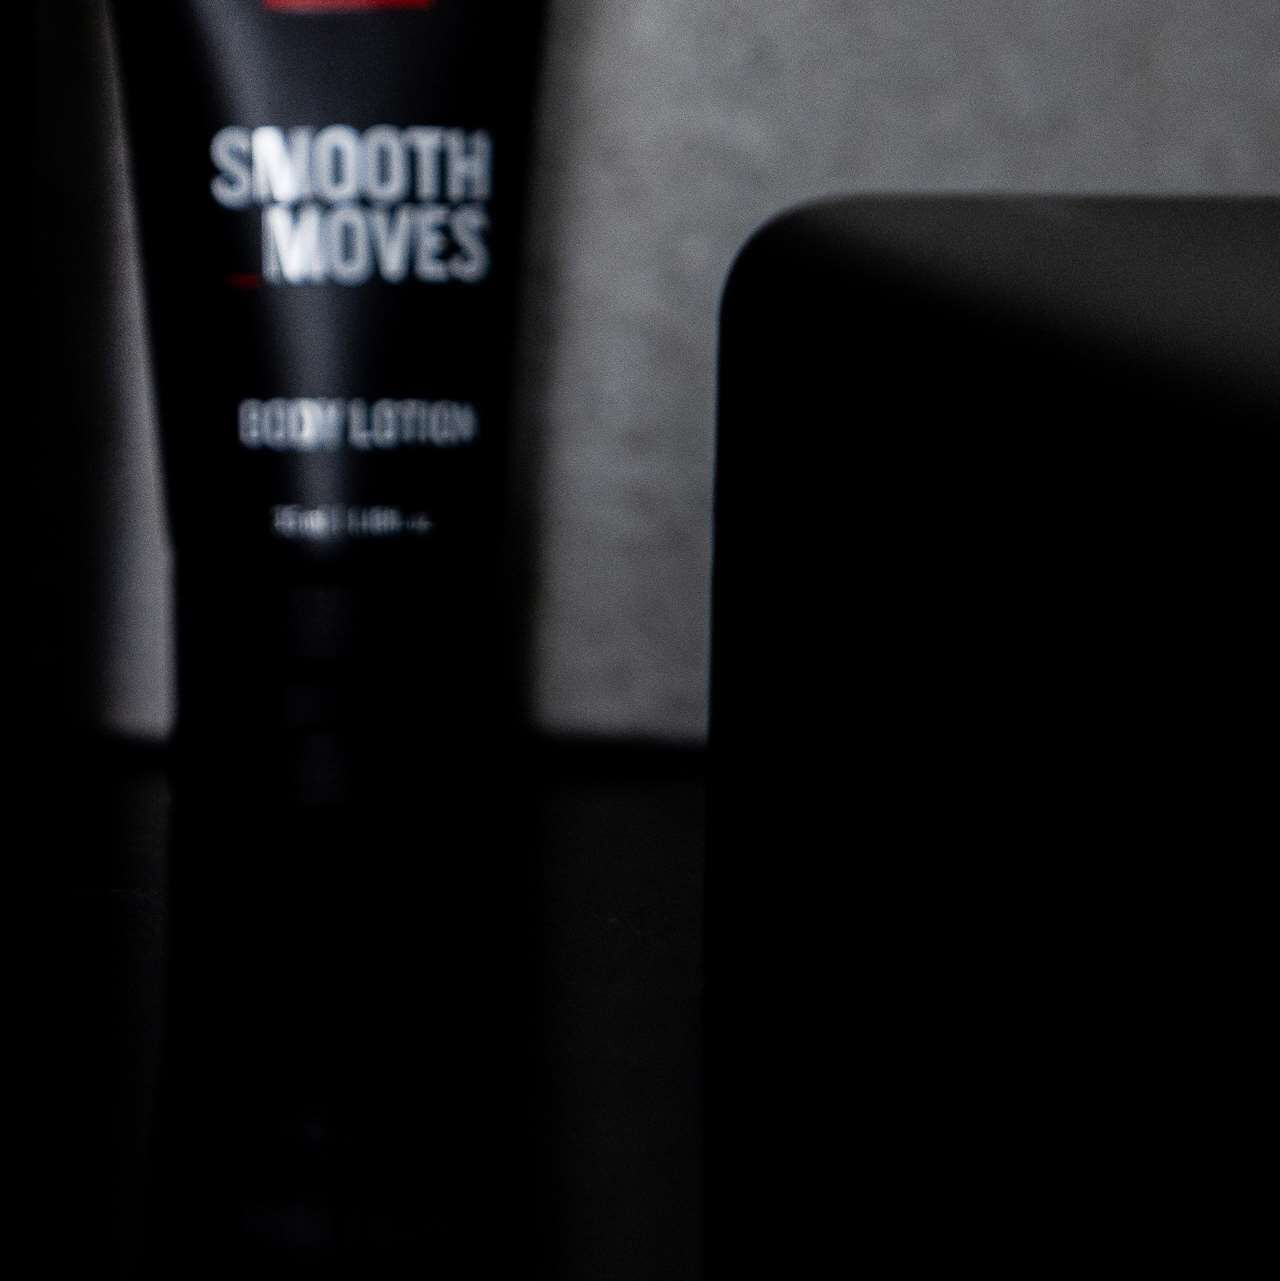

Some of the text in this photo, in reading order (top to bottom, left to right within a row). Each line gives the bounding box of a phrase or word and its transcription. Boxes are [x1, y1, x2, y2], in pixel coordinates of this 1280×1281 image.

[209, 124, 491, 208] SMOOTH
[262, 203, 491, 286] MOVES
[238, 397, 478, 451] BODY LOTION
